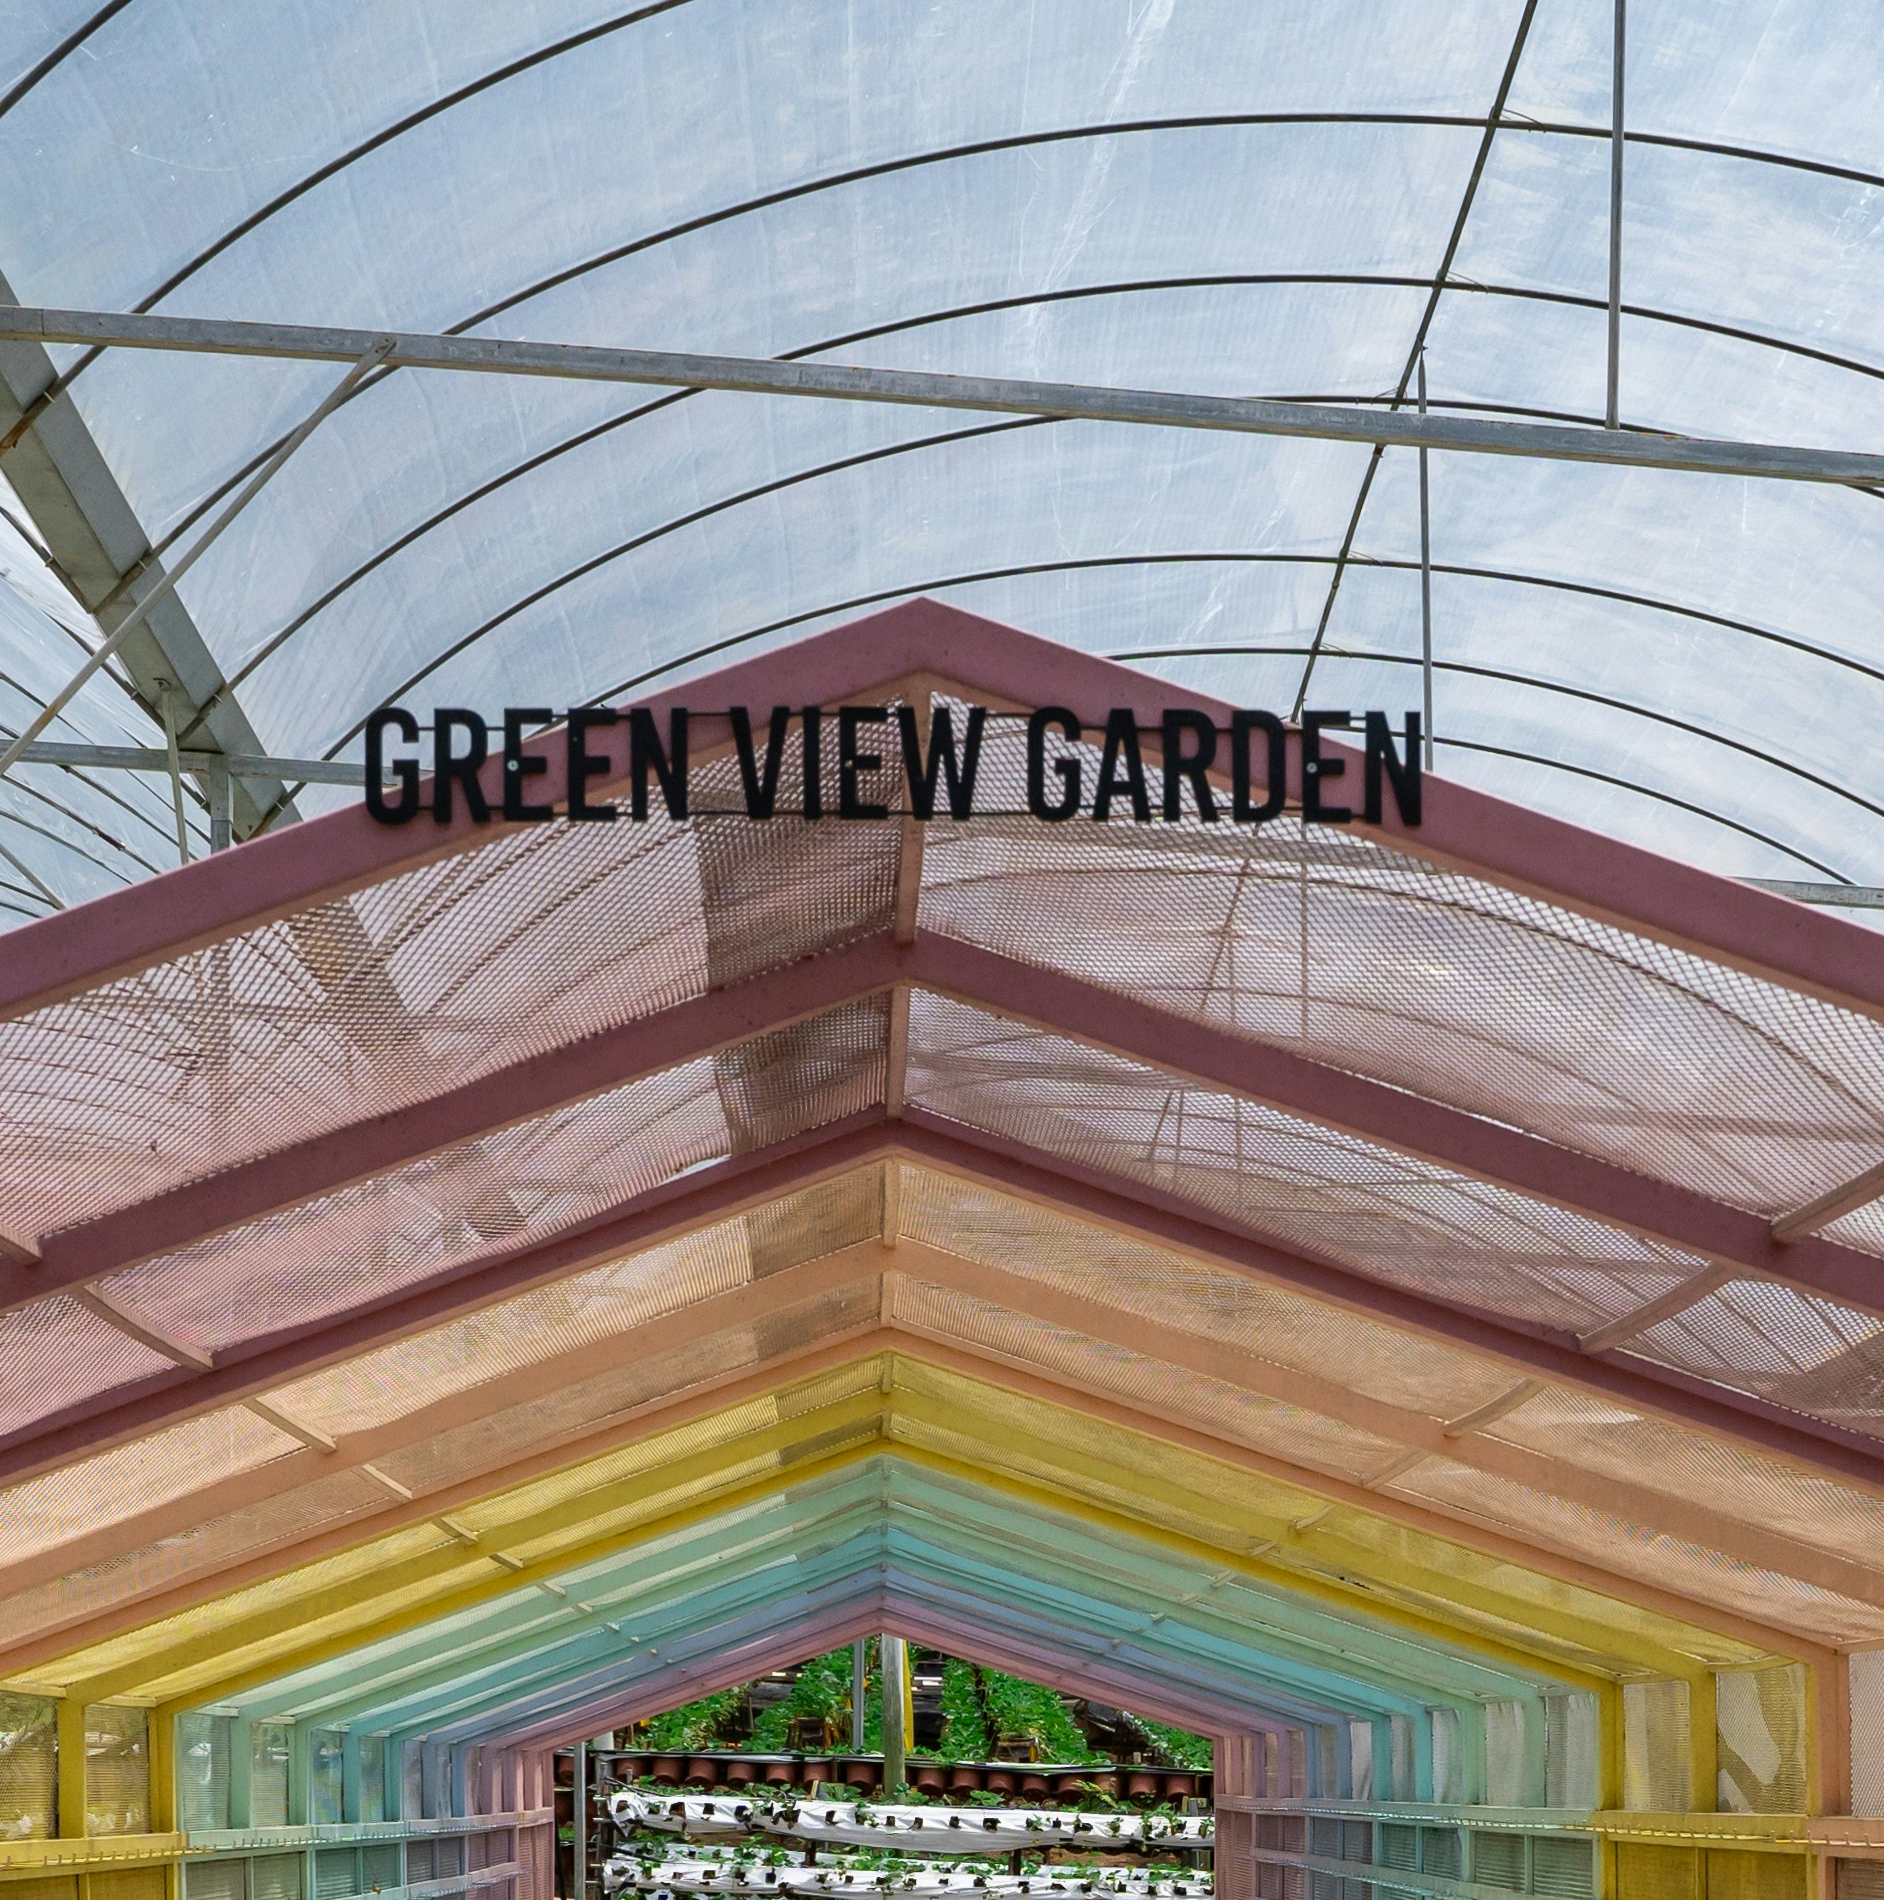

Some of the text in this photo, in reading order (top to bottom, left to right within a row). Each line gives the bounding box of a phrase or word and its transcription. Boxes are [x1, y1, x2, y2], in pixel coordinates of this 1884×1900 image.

[364, 706, 1422, 826] GREEN VIEW GARDEN
